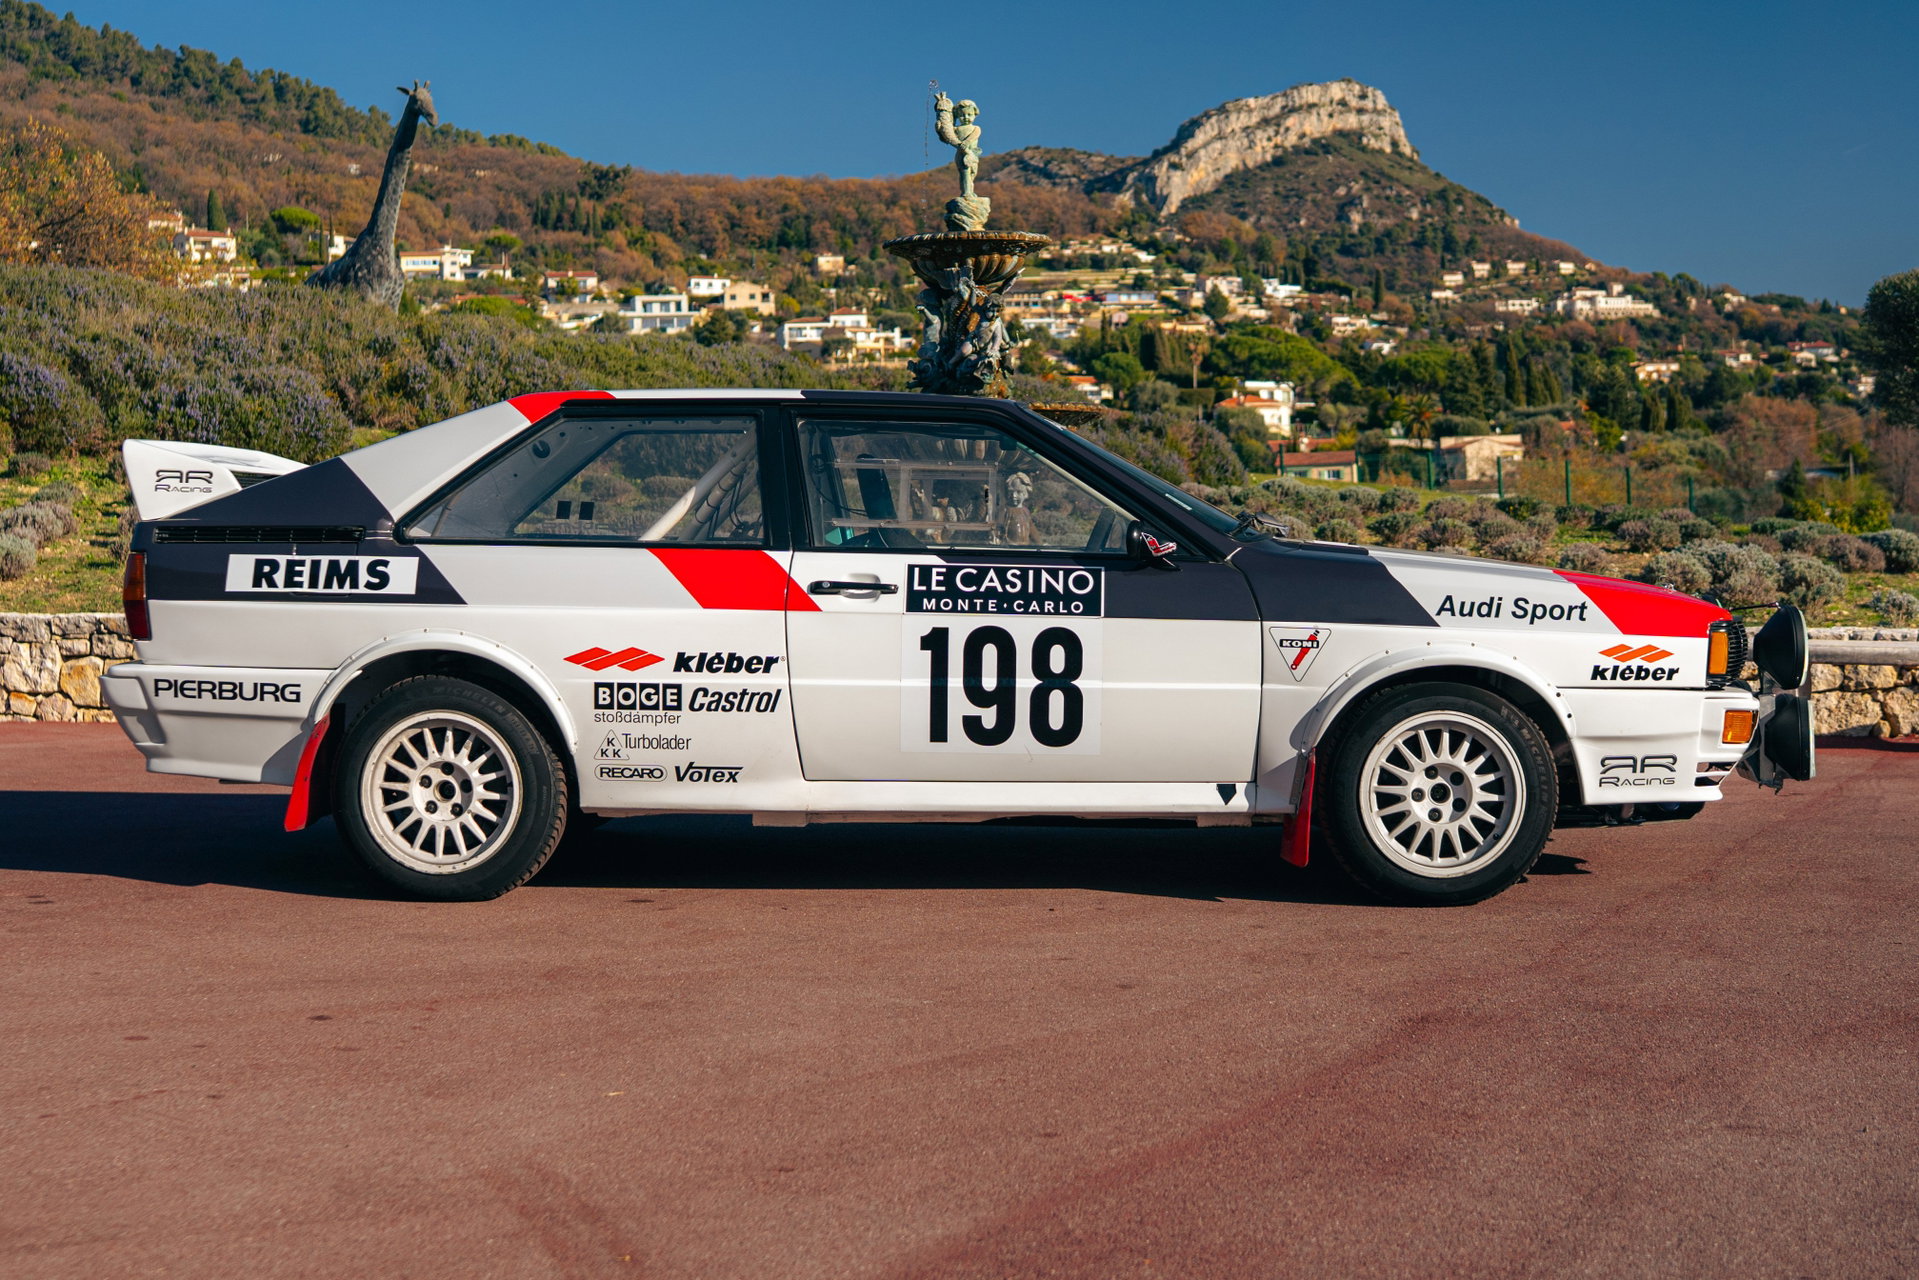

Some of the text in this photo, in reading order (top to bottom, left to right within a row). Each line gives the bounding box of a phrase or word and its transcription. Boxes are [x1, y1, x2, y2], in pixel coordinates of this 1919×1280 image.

[251, 558, 391, 590] REIMS
[913, 567, 1094, 595] LE CASINO
[1436, 594, 1588, 625] Audi Sport
[1282, 640, 1317, 648] KONI
[1591, 665, 1679, 682] kléber
[154, 678, 301, 702] PIERBURG
[598, 687, 678, 706] BOGE
[920, 625, 1083, 747] 198
[688, 687, 782, 713] Castrol
[622, 733, 692, 750] Turbolader
[599, 767, 664, 779] RECARO
